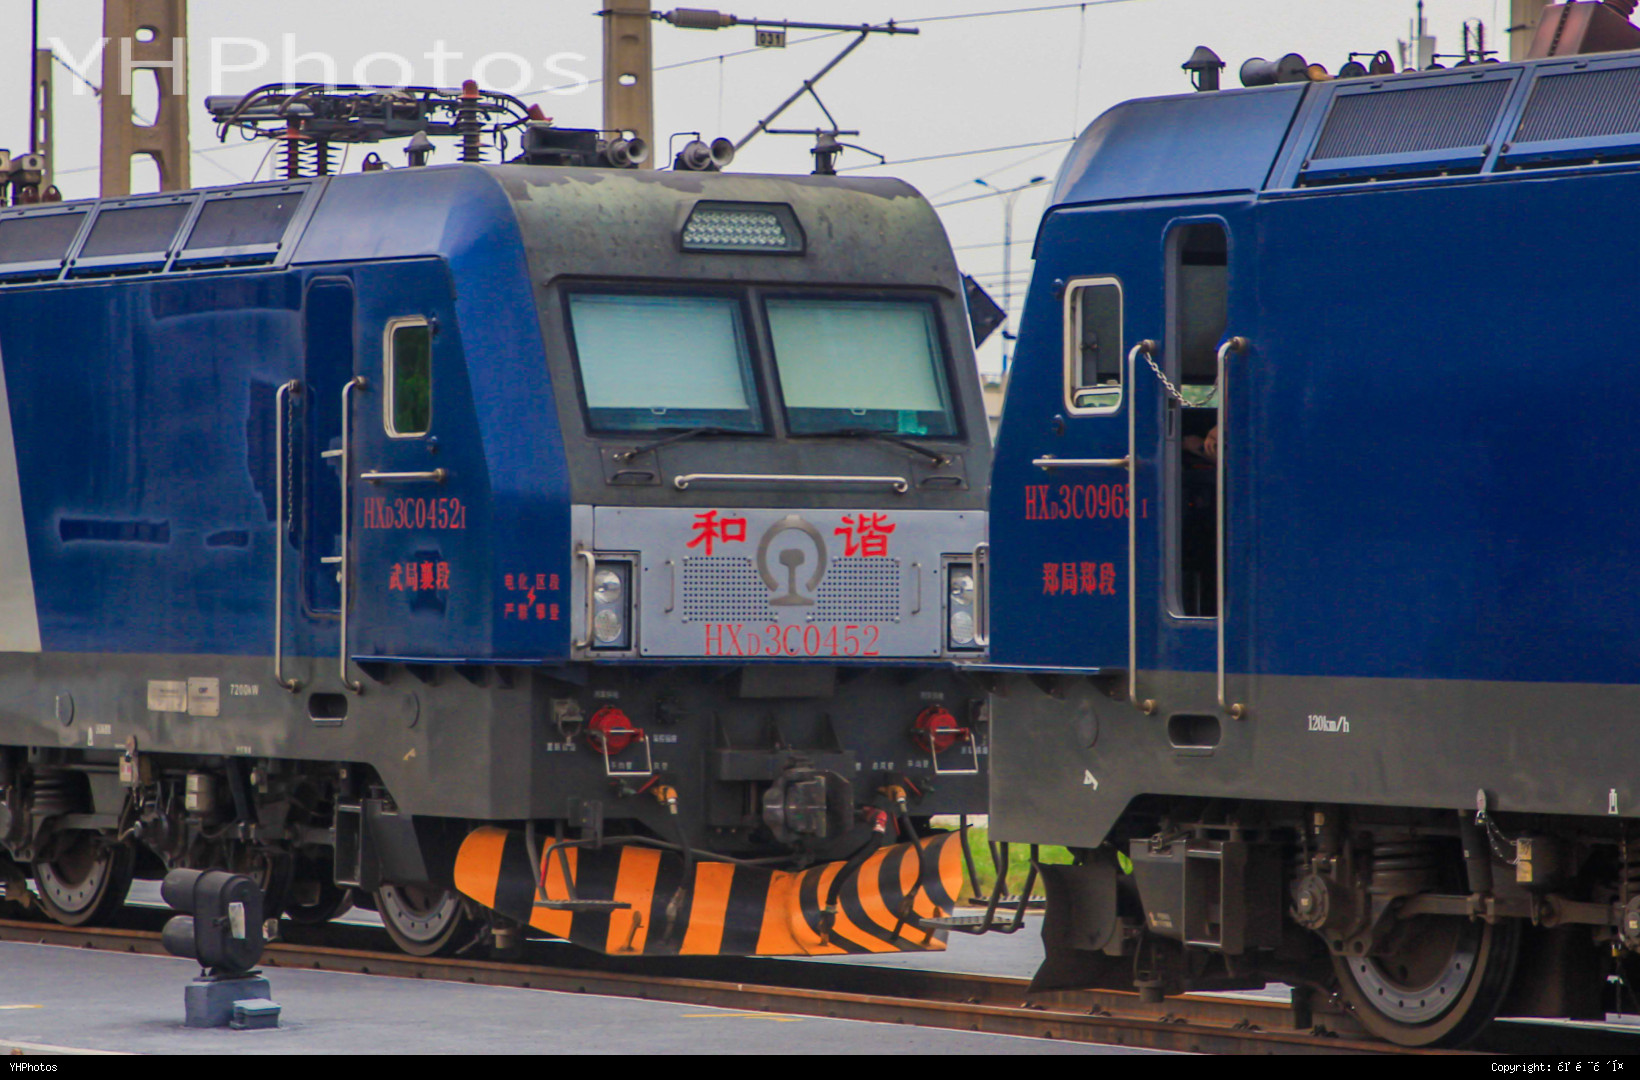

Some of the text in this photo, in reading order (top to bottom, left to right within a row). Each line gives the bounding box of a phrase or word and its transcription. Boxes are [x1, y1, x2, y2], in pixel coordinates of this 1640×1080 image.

[686, 510, 896, 558] 和 谐
[704, 624, 880, 657] HXD3C0452
[1308, 715, 1350, 733] 120km/h
